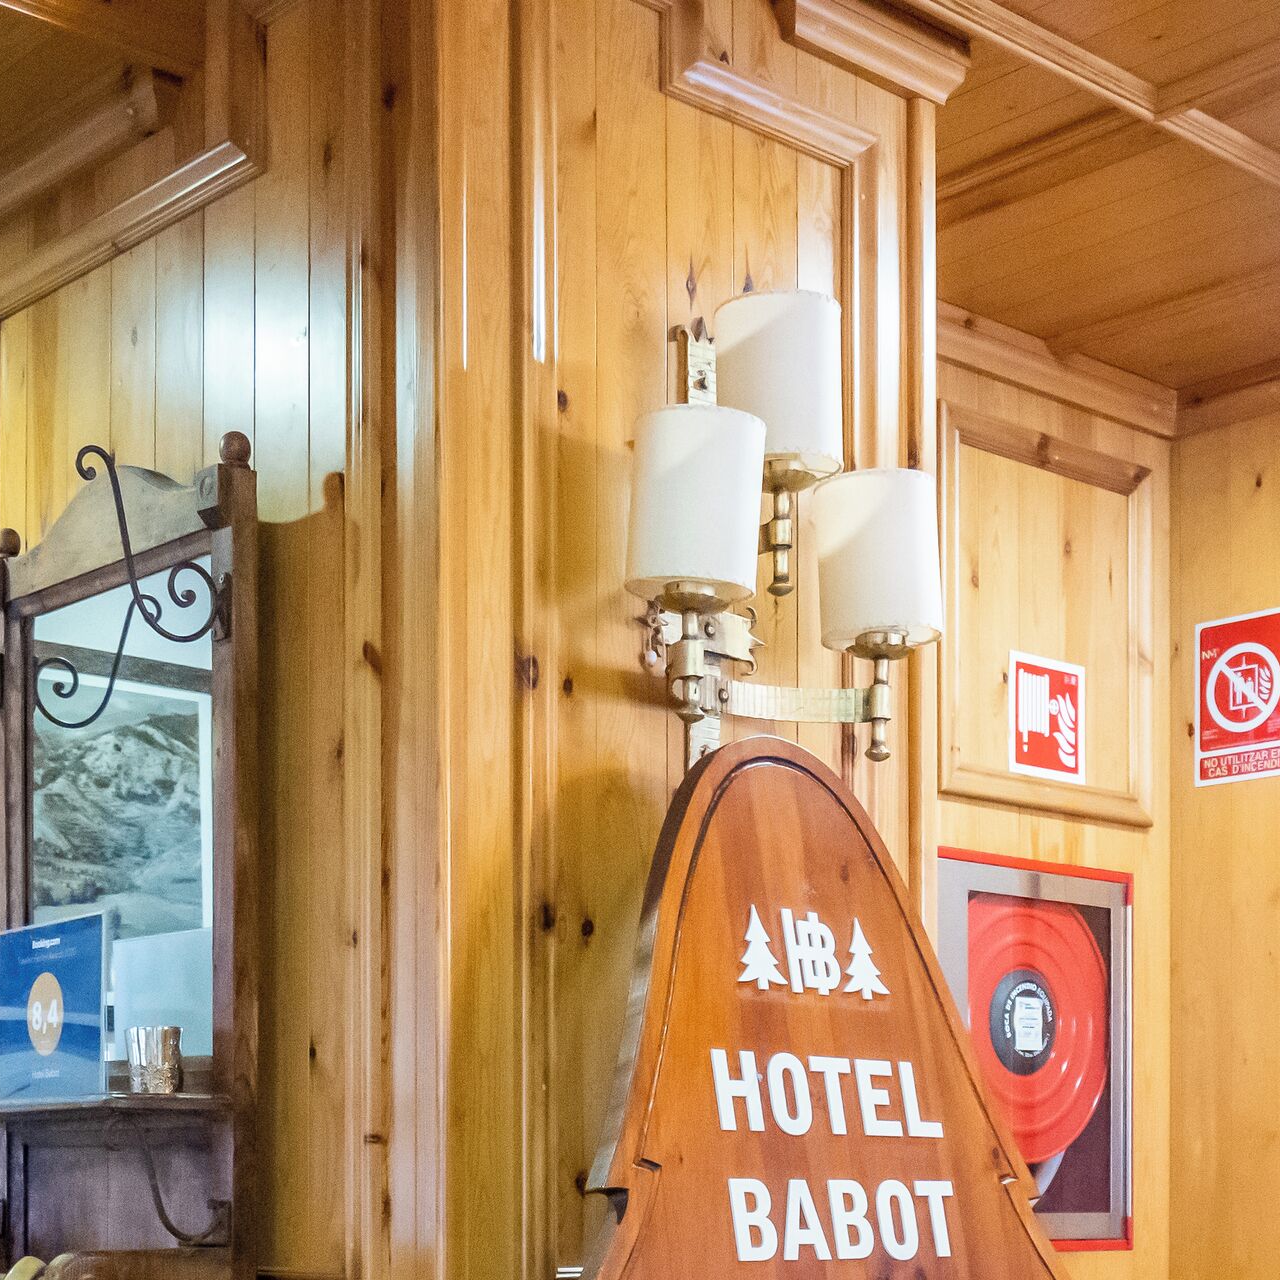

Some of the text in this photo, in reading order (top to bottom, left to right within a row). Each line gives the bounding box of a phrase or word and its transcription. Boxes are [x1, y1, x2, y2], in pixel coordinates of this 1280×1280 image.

[1204, 758, 1219, 769] NO
[1220, 750, 1269, 766] UTILITZAR
[1208, 759, 1280, 778] CAS D'INCENDI
[32, 999, 59, 1034] 8,4
[710, 1047, 945, 1139] HOTEL
[728, 1177, 954, 1262] BABOT
